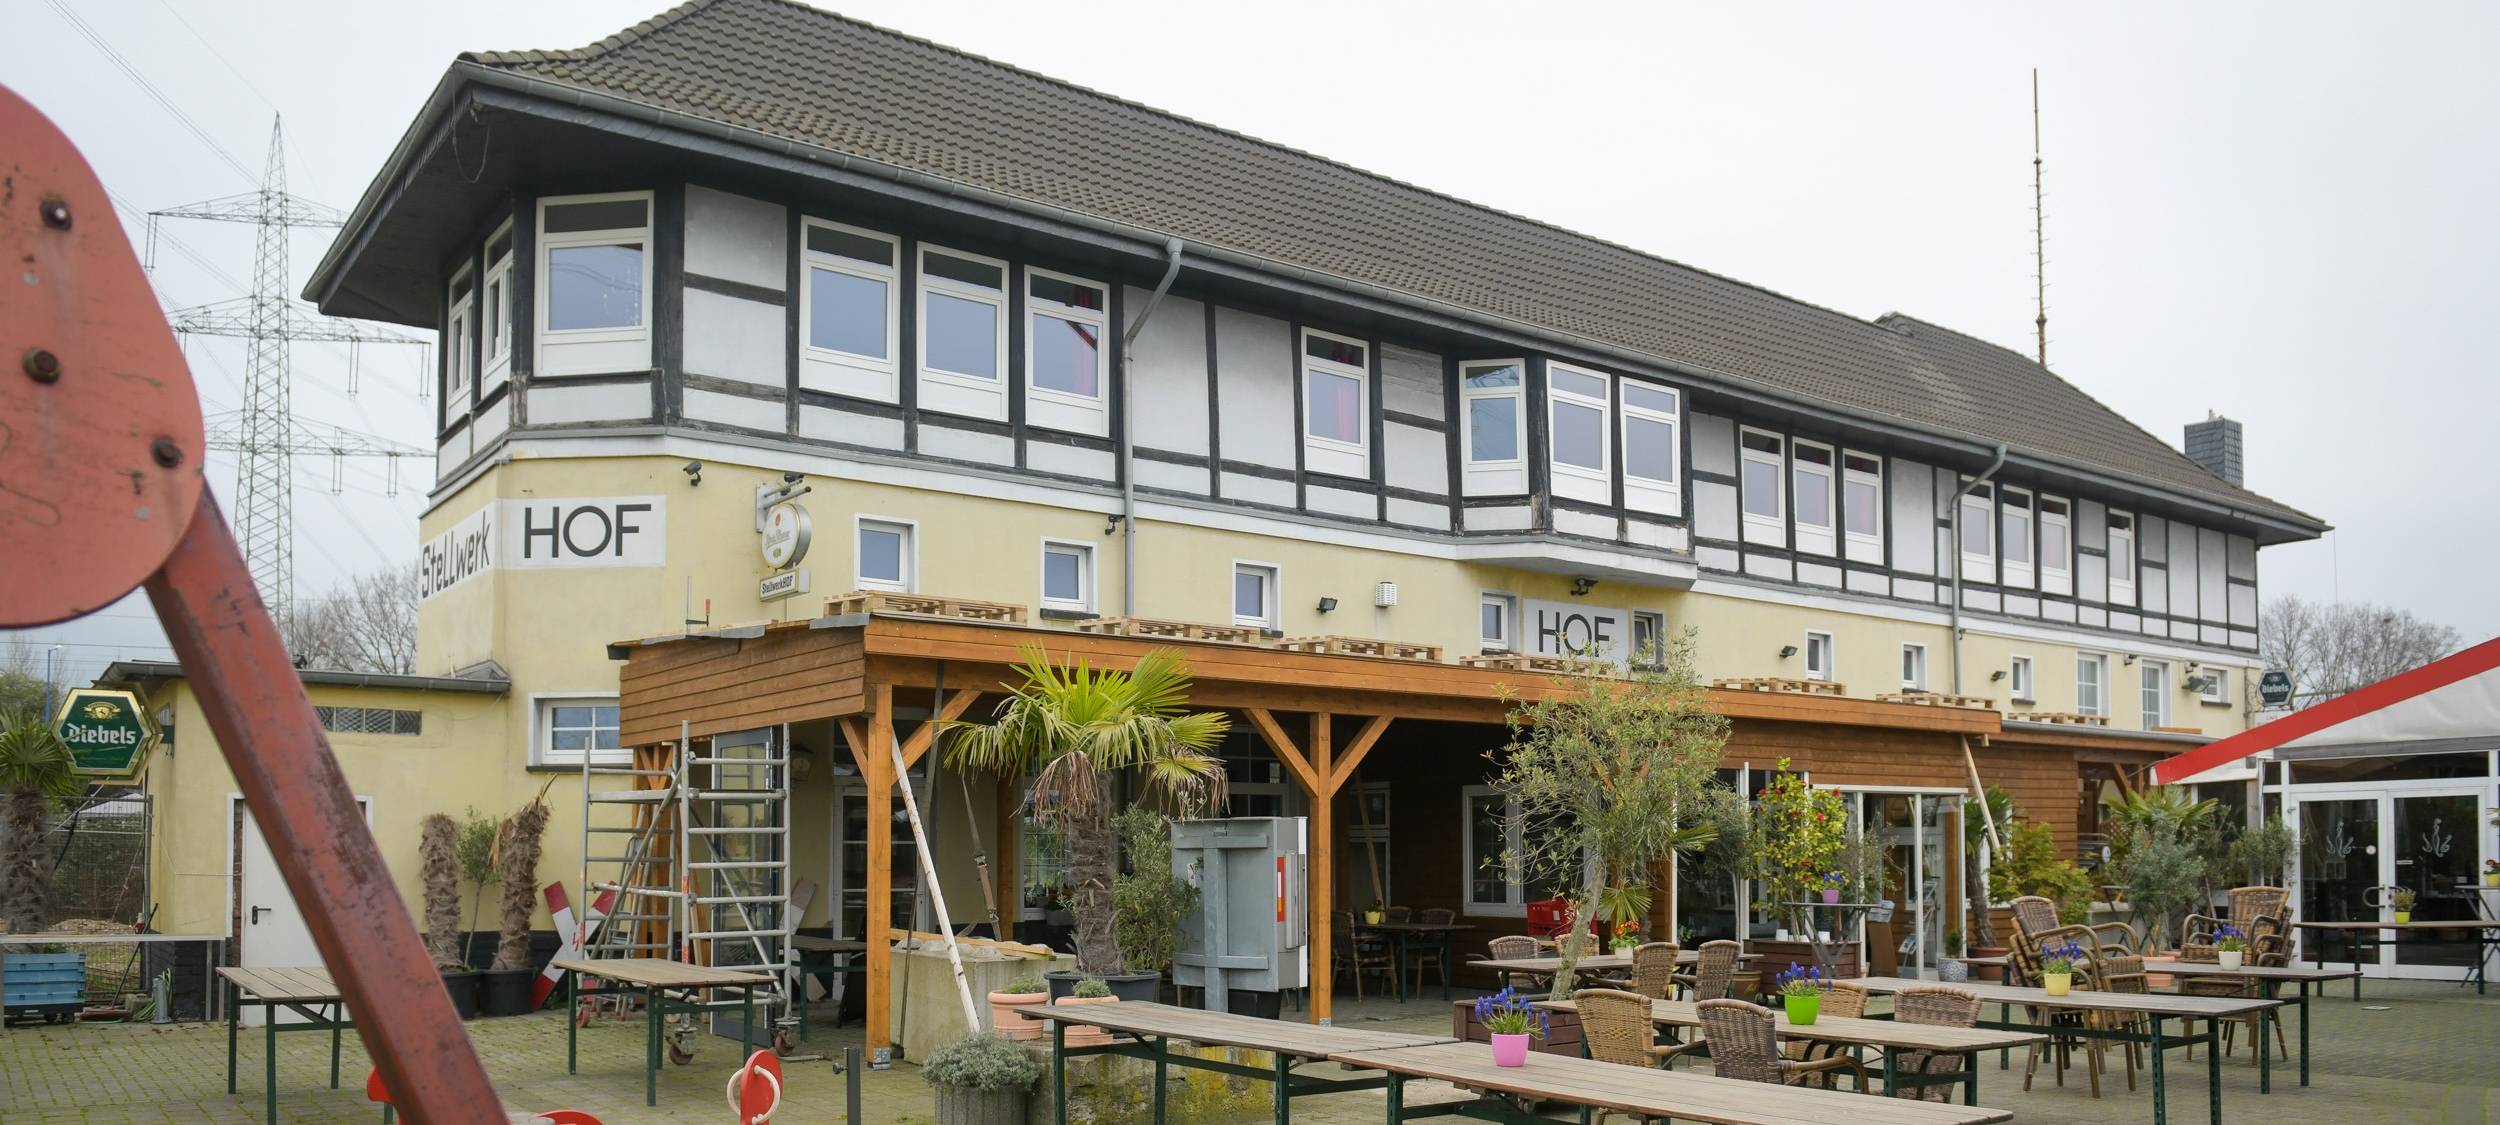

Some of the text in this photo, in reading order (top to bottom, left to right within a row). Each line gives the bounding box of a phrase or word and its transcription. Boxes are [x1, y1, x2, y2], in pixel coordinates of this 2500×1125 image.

[422, 511, 490, 599] Stellwerk
[524, 504, 651, 558] HOF
[1538, 609, 1615, 657] HOF
[67, 723, 136, 745] Diebels
